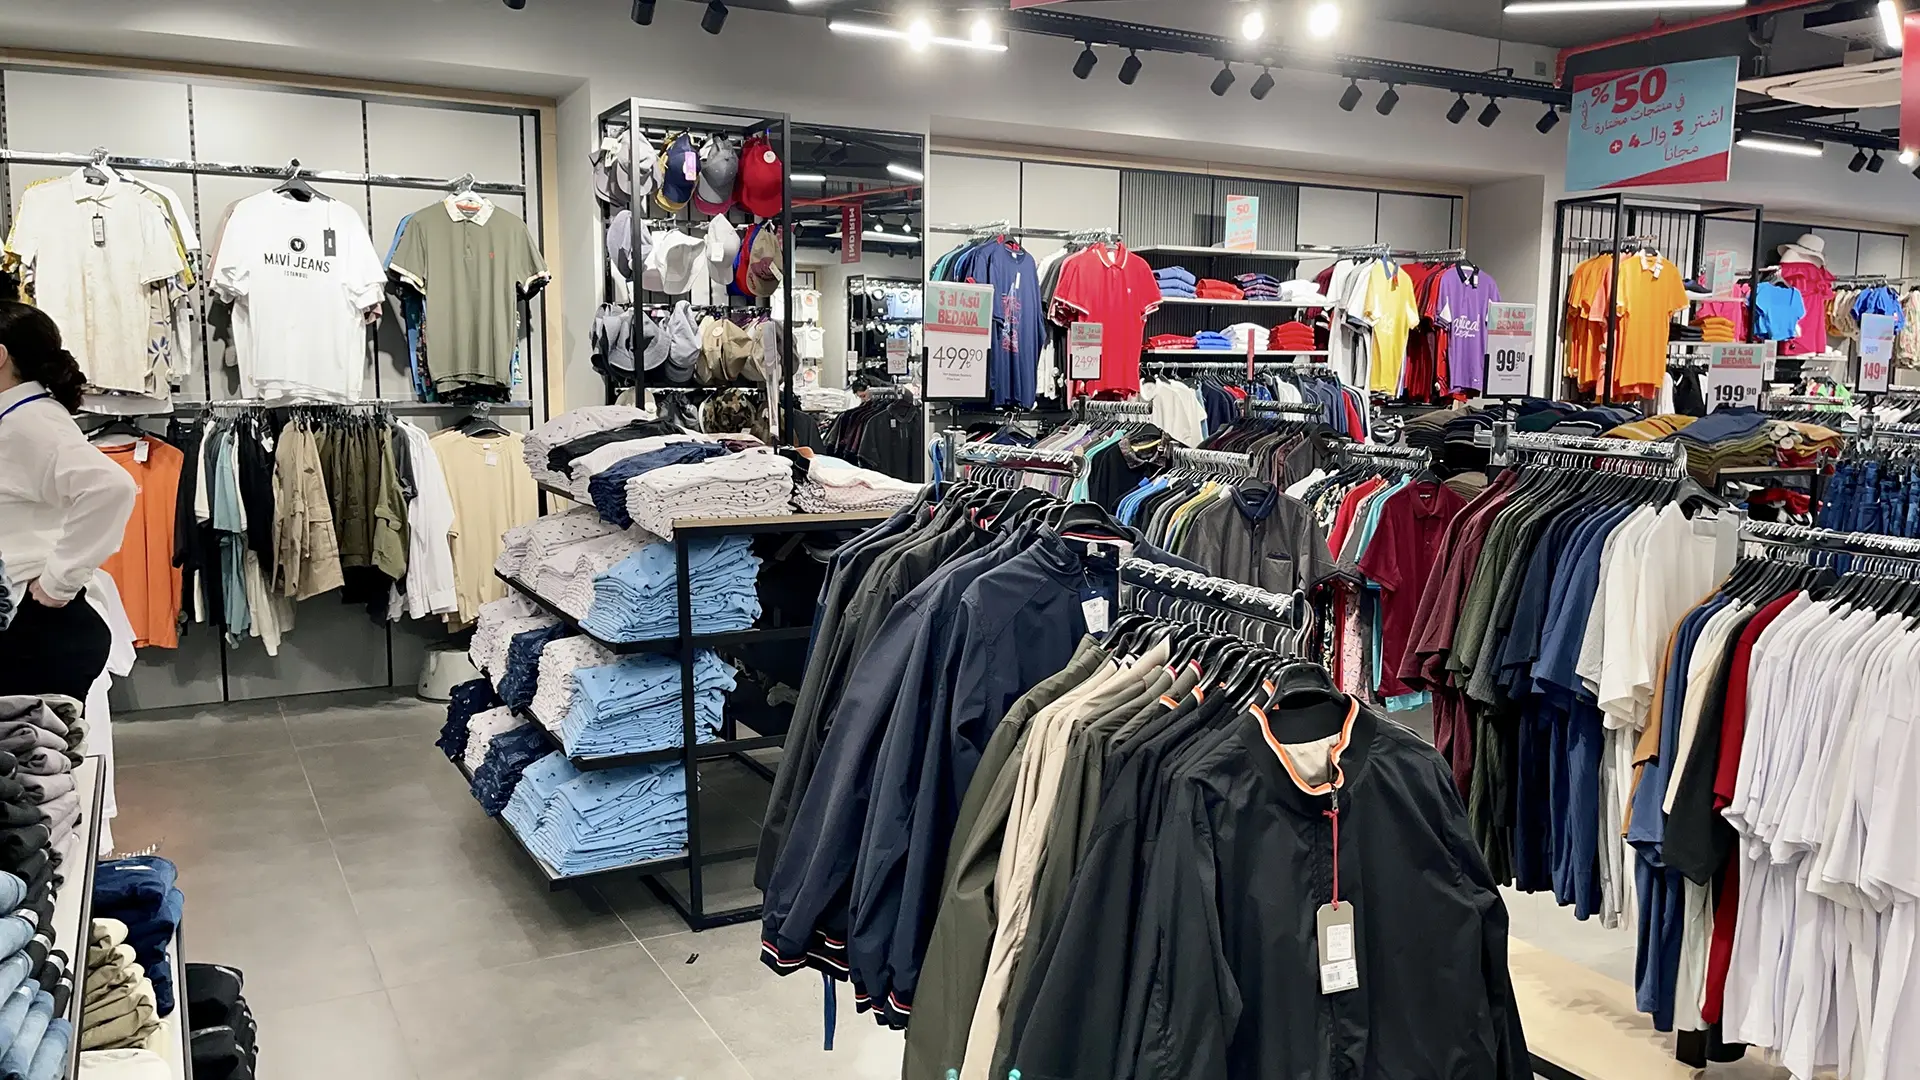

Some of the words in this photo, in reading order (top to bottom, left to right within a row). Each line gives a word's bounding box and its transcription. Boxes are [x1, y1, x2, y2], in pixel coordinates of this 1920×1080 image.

[1630, 102, 1673, 121] منتجات
[1675, 93, 1685, 112] في
[1594, 116, 1628, 135] مختارة
[1672, 120, 1684, 136] 3
[293, 256, 330, 274] JEANS
[939, 290, 946, 307] 3
[938, 308, 979, 327] BEDAVA
